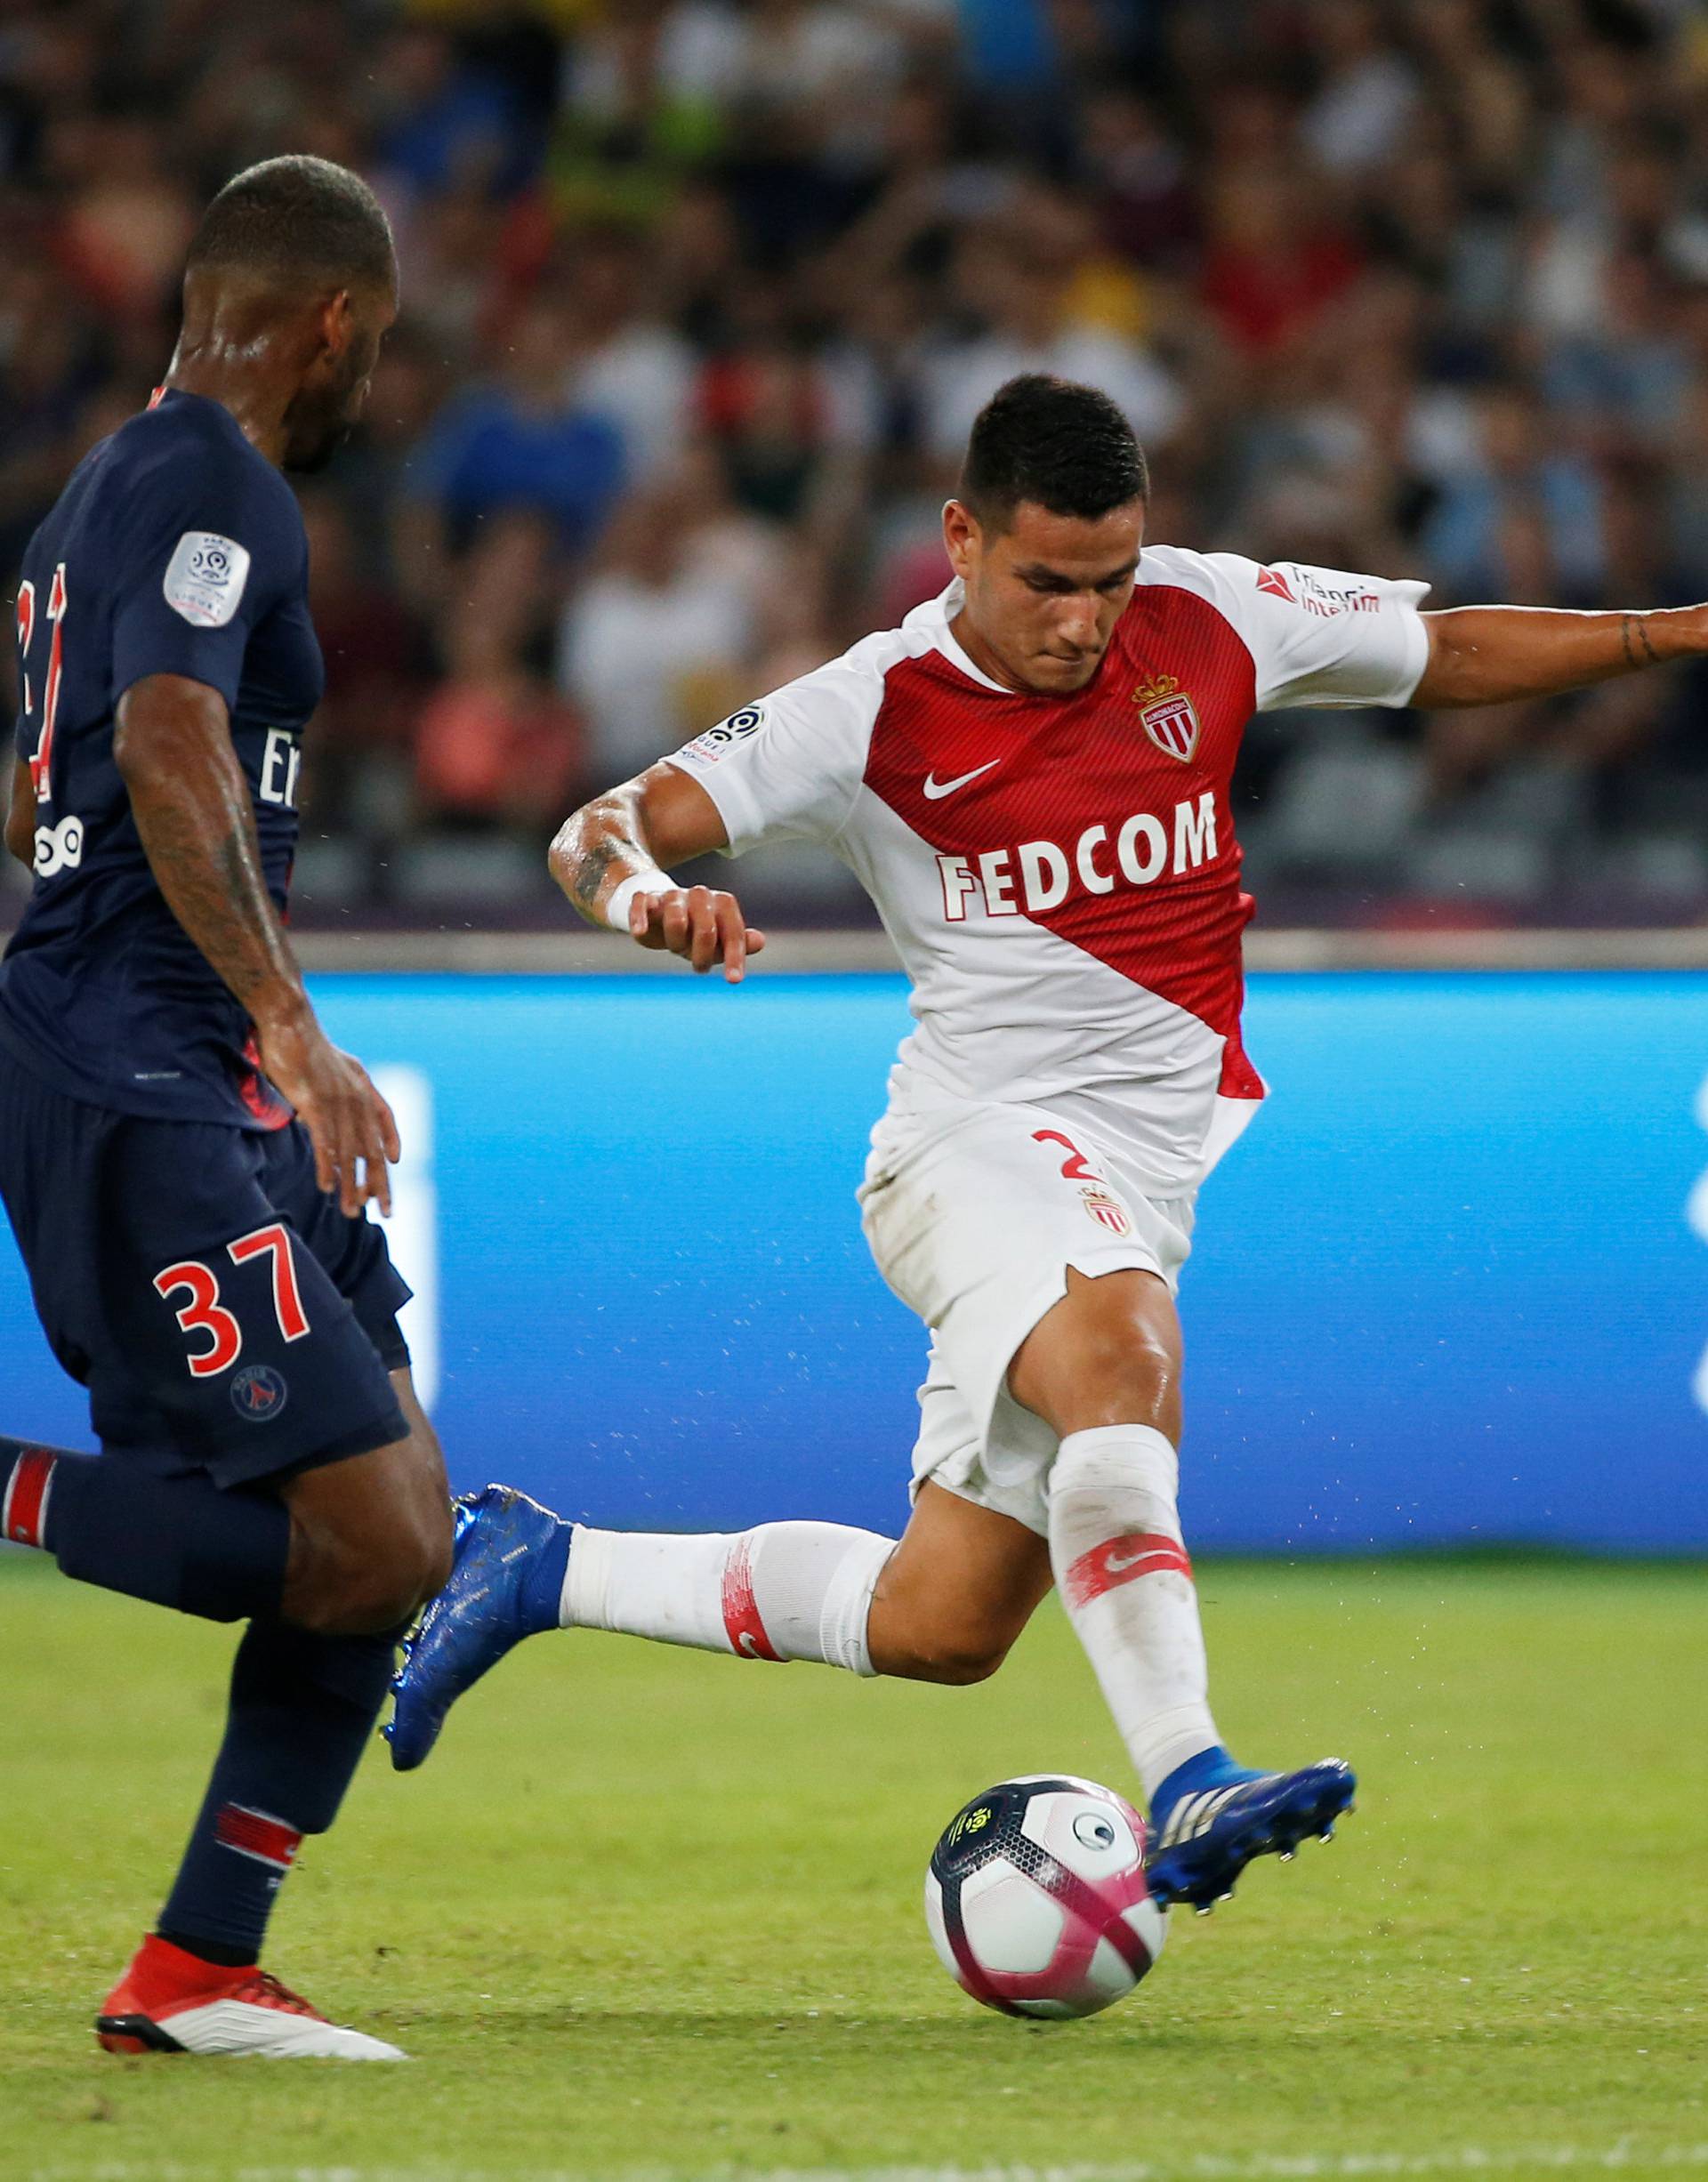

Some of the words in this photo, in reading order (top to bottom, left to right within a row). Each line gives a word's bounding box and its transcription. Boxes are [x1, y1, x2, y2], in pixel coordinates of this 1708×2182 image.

[936, 791, 1219, 922] FEDCOM
[1030, 1129, 1109, 1185] 2
[152, 1222, 311, 1378] 37
